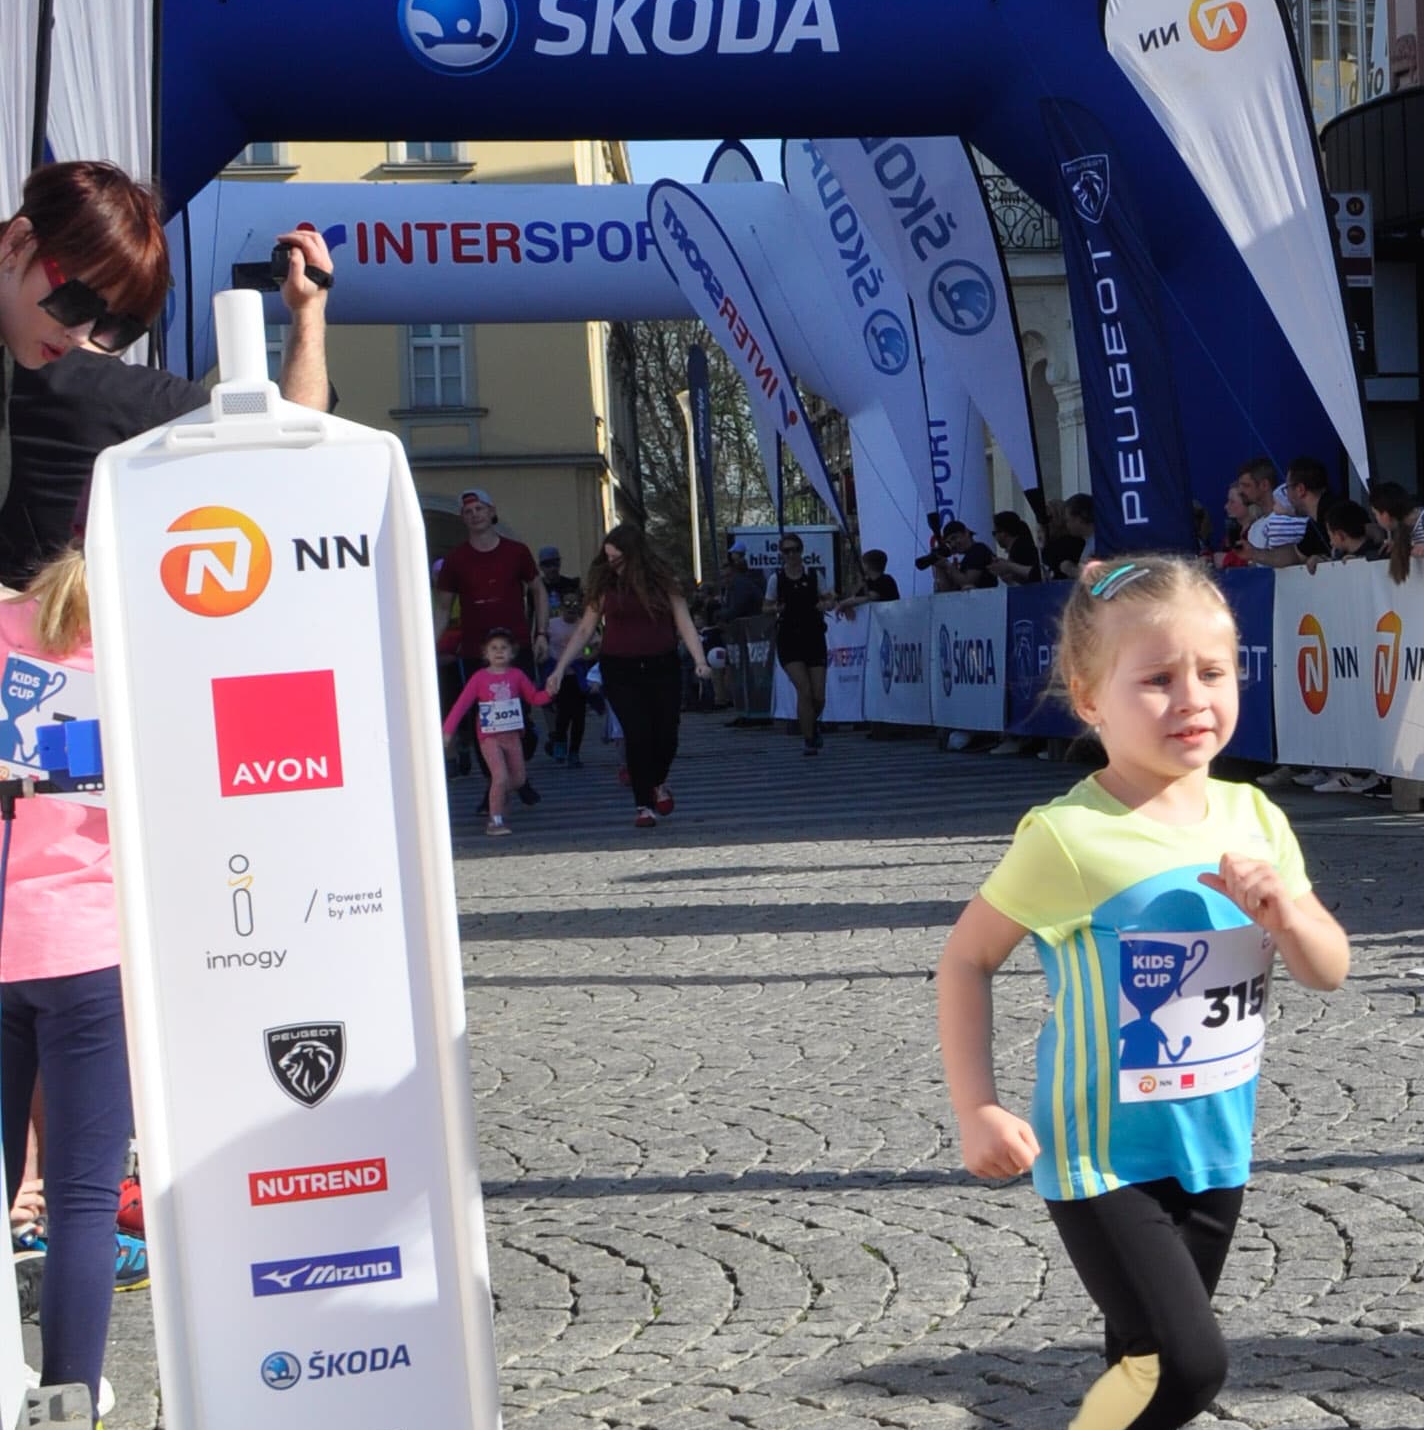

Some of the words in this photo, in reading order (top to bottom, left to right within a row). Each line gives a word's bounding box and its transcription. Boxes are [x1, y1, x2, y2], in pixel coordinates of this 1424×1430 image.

[1087, 239, 1149, 525] PEUGEOT
[292, 533, 371, 572] NN
[953, 631, 996, 685] ŠKODA
[1333, 647, 1359, 679] NN
[11, 671, 41, 688] KIDS
[8, 685, 36, 700] CUP
[233, 756, 328, 787] AVON
[327, 887, 383, 905] Powered
[328, 905, 345, 919] by
[349, 902, 384, 916] MVM
[206, 946, 287, 970] innogy
[1132, 955, 1175, 970] KIDS
[1133, 973, 1171, 988] CUP
[271, 1027, 338, 1044] PEUGEOT
[257, 1164, 381, 1201] NUTREND
[307, 1343, 411, 1381] ŠKODA
